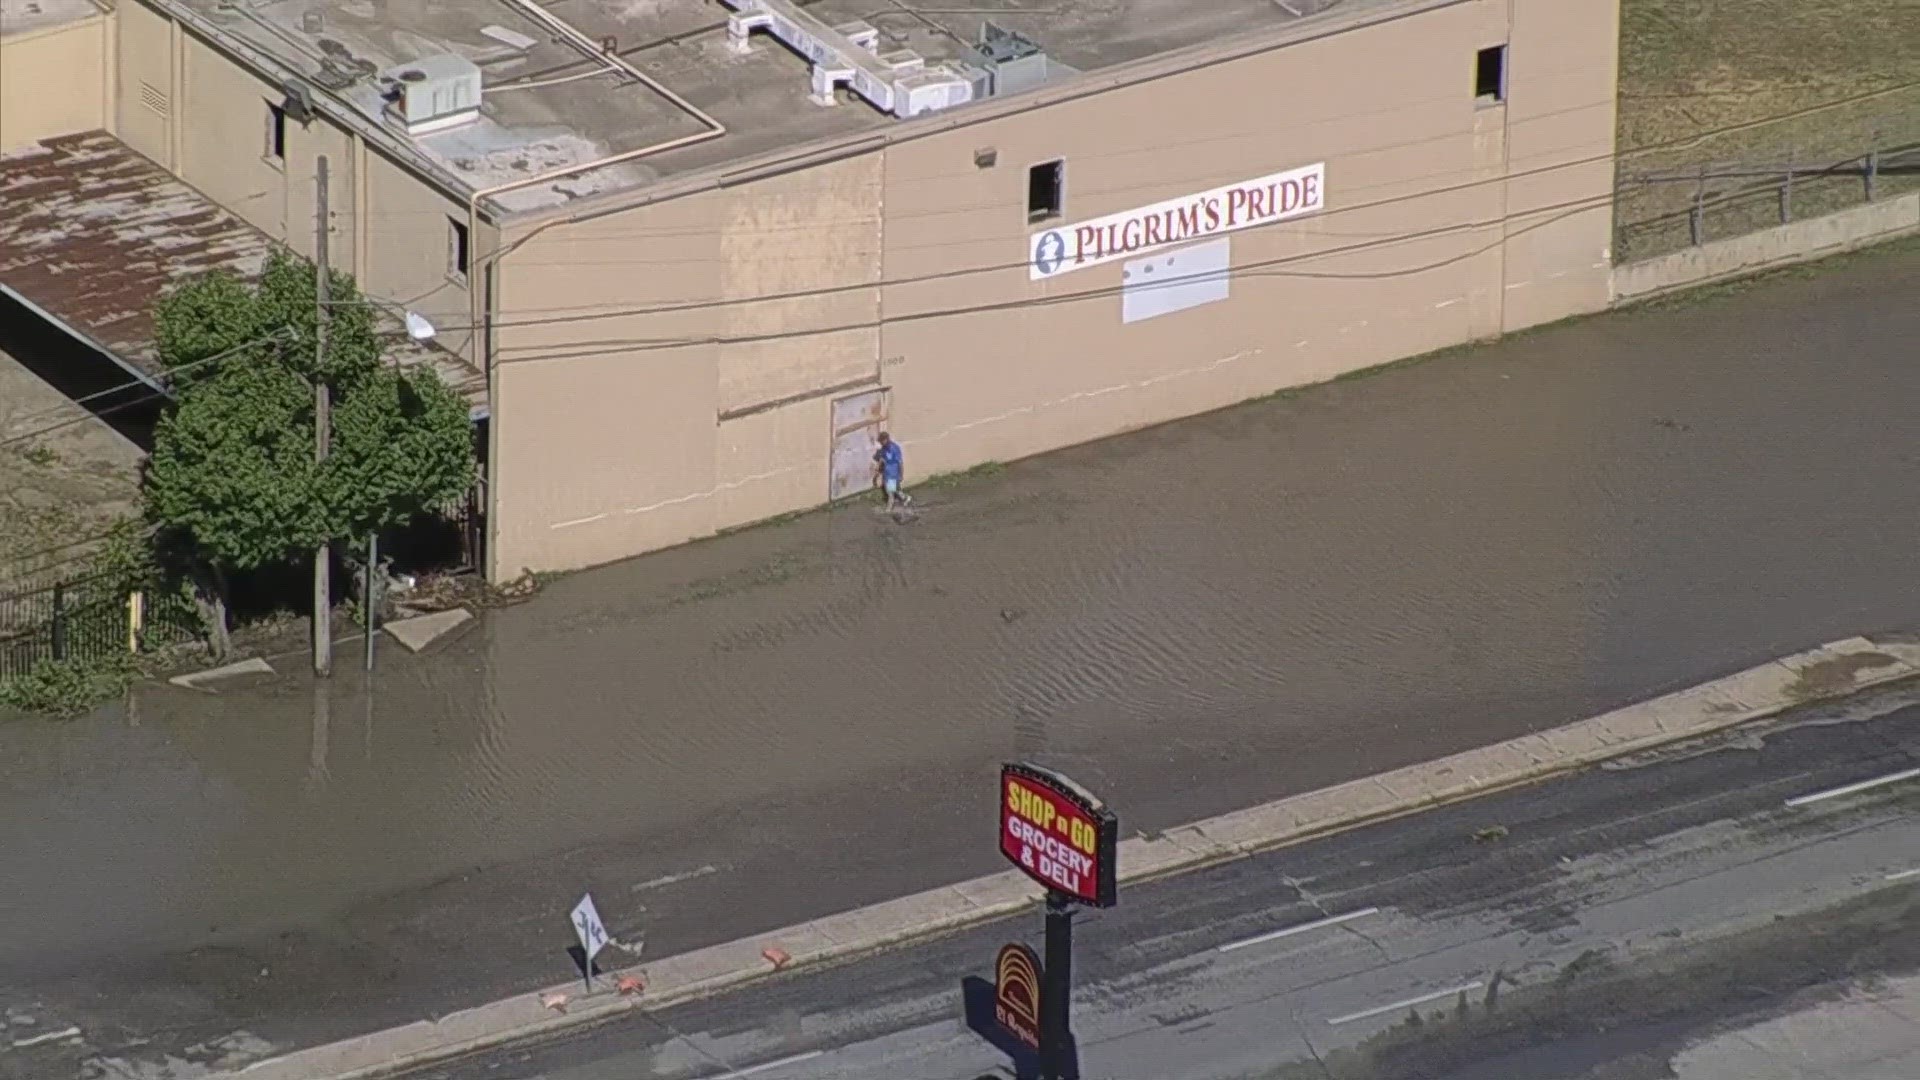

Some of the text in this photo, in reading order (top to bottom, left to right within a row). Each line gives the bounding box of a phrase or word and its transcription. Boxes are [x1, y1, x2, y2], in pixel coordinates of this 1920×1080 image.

[1074, 173, 1319, 264] PILGRIM'S PRIDE
[1008, 780, 1055, 830] SHOP
[1071, 816, 1096, 855] GO
[1008, 815, 1094, 878] GROCERY
[1021, 845, 1079, 895] & DELI
